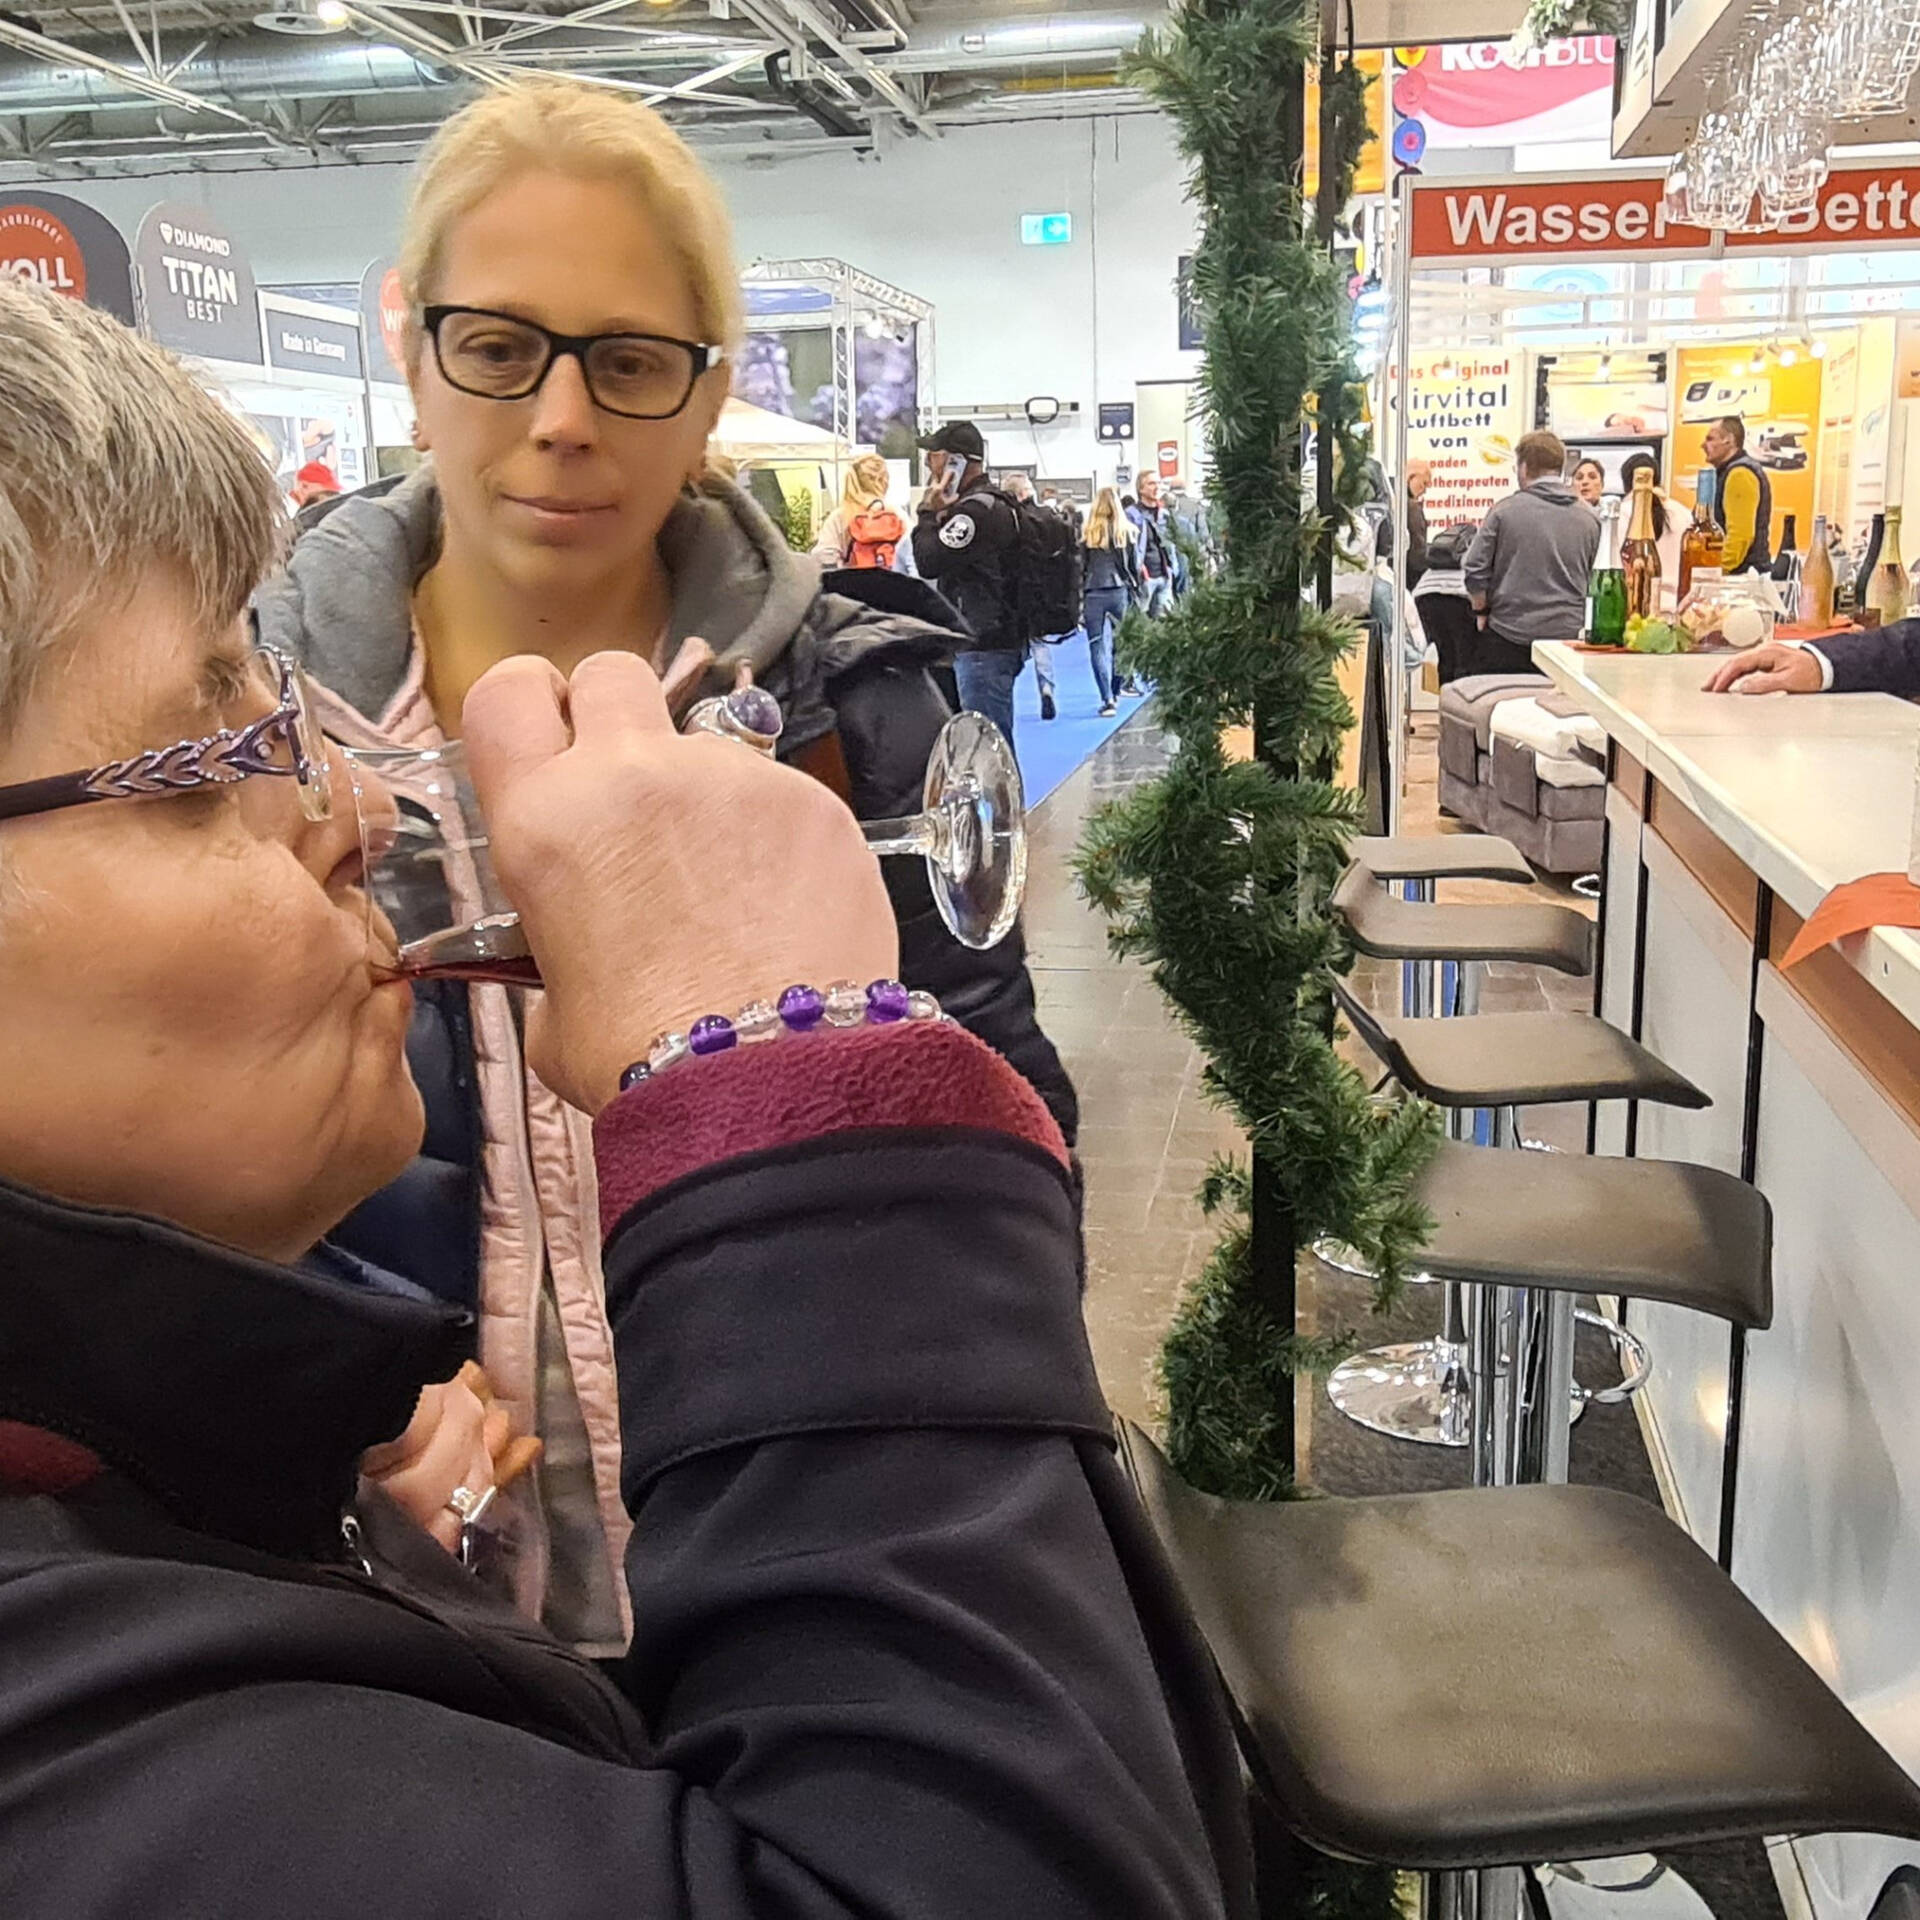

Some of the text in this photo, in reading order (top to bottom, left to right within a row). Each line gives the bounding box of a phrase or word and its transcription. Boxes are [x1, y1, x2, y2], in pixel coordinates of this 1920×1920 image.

[1444, 193, 1673, 246] Wasser
[174, 227, 230, 257] DIAMOND
[0, 256, 75, 288] OLL
[186, 299, 222, 323] BEST
[1431, 358, 1509, 381] Oiginal
[1429, 437, 1468, 448] von
